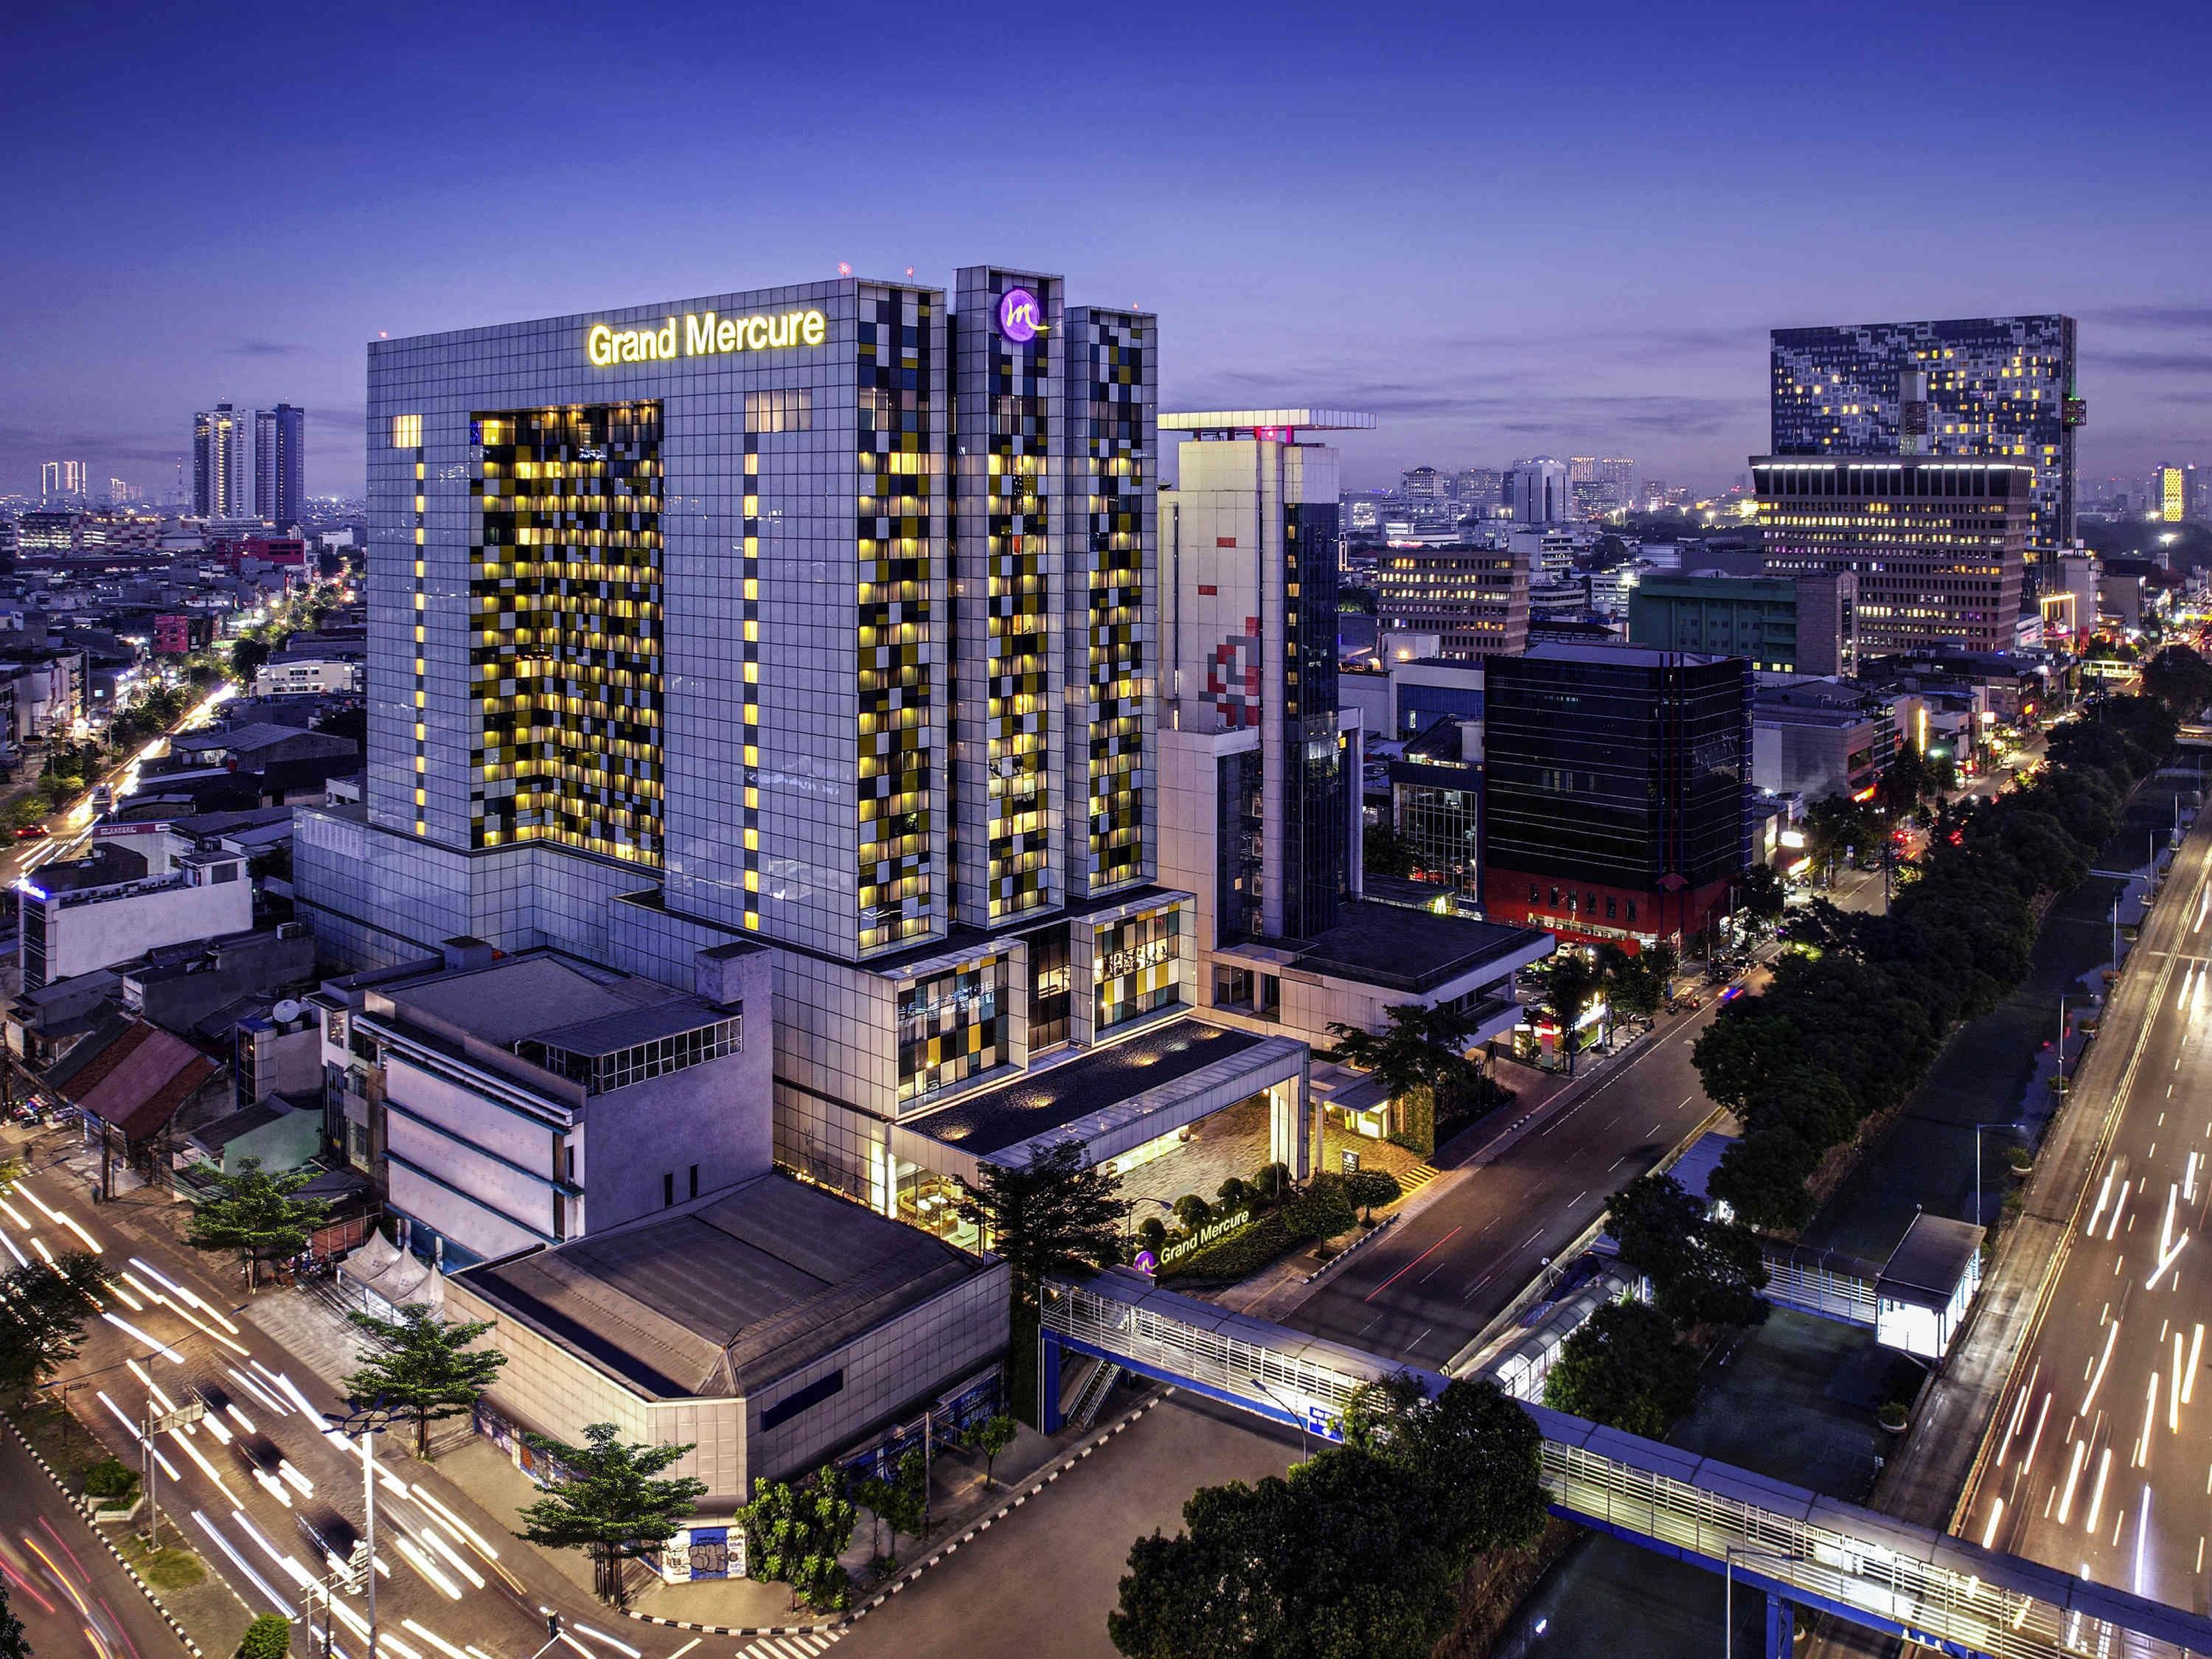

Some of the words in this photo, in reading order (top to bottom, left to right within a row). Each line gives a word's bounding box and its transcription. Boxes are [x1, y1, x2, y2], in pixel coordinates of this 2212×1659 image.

[588, 316, 677, 366] Grand
[686, 310, 825, 357] Mercure
[1161, 1234, 1198, 1265] Grand
[1200, 1210, 1250, 1245] Mercure
